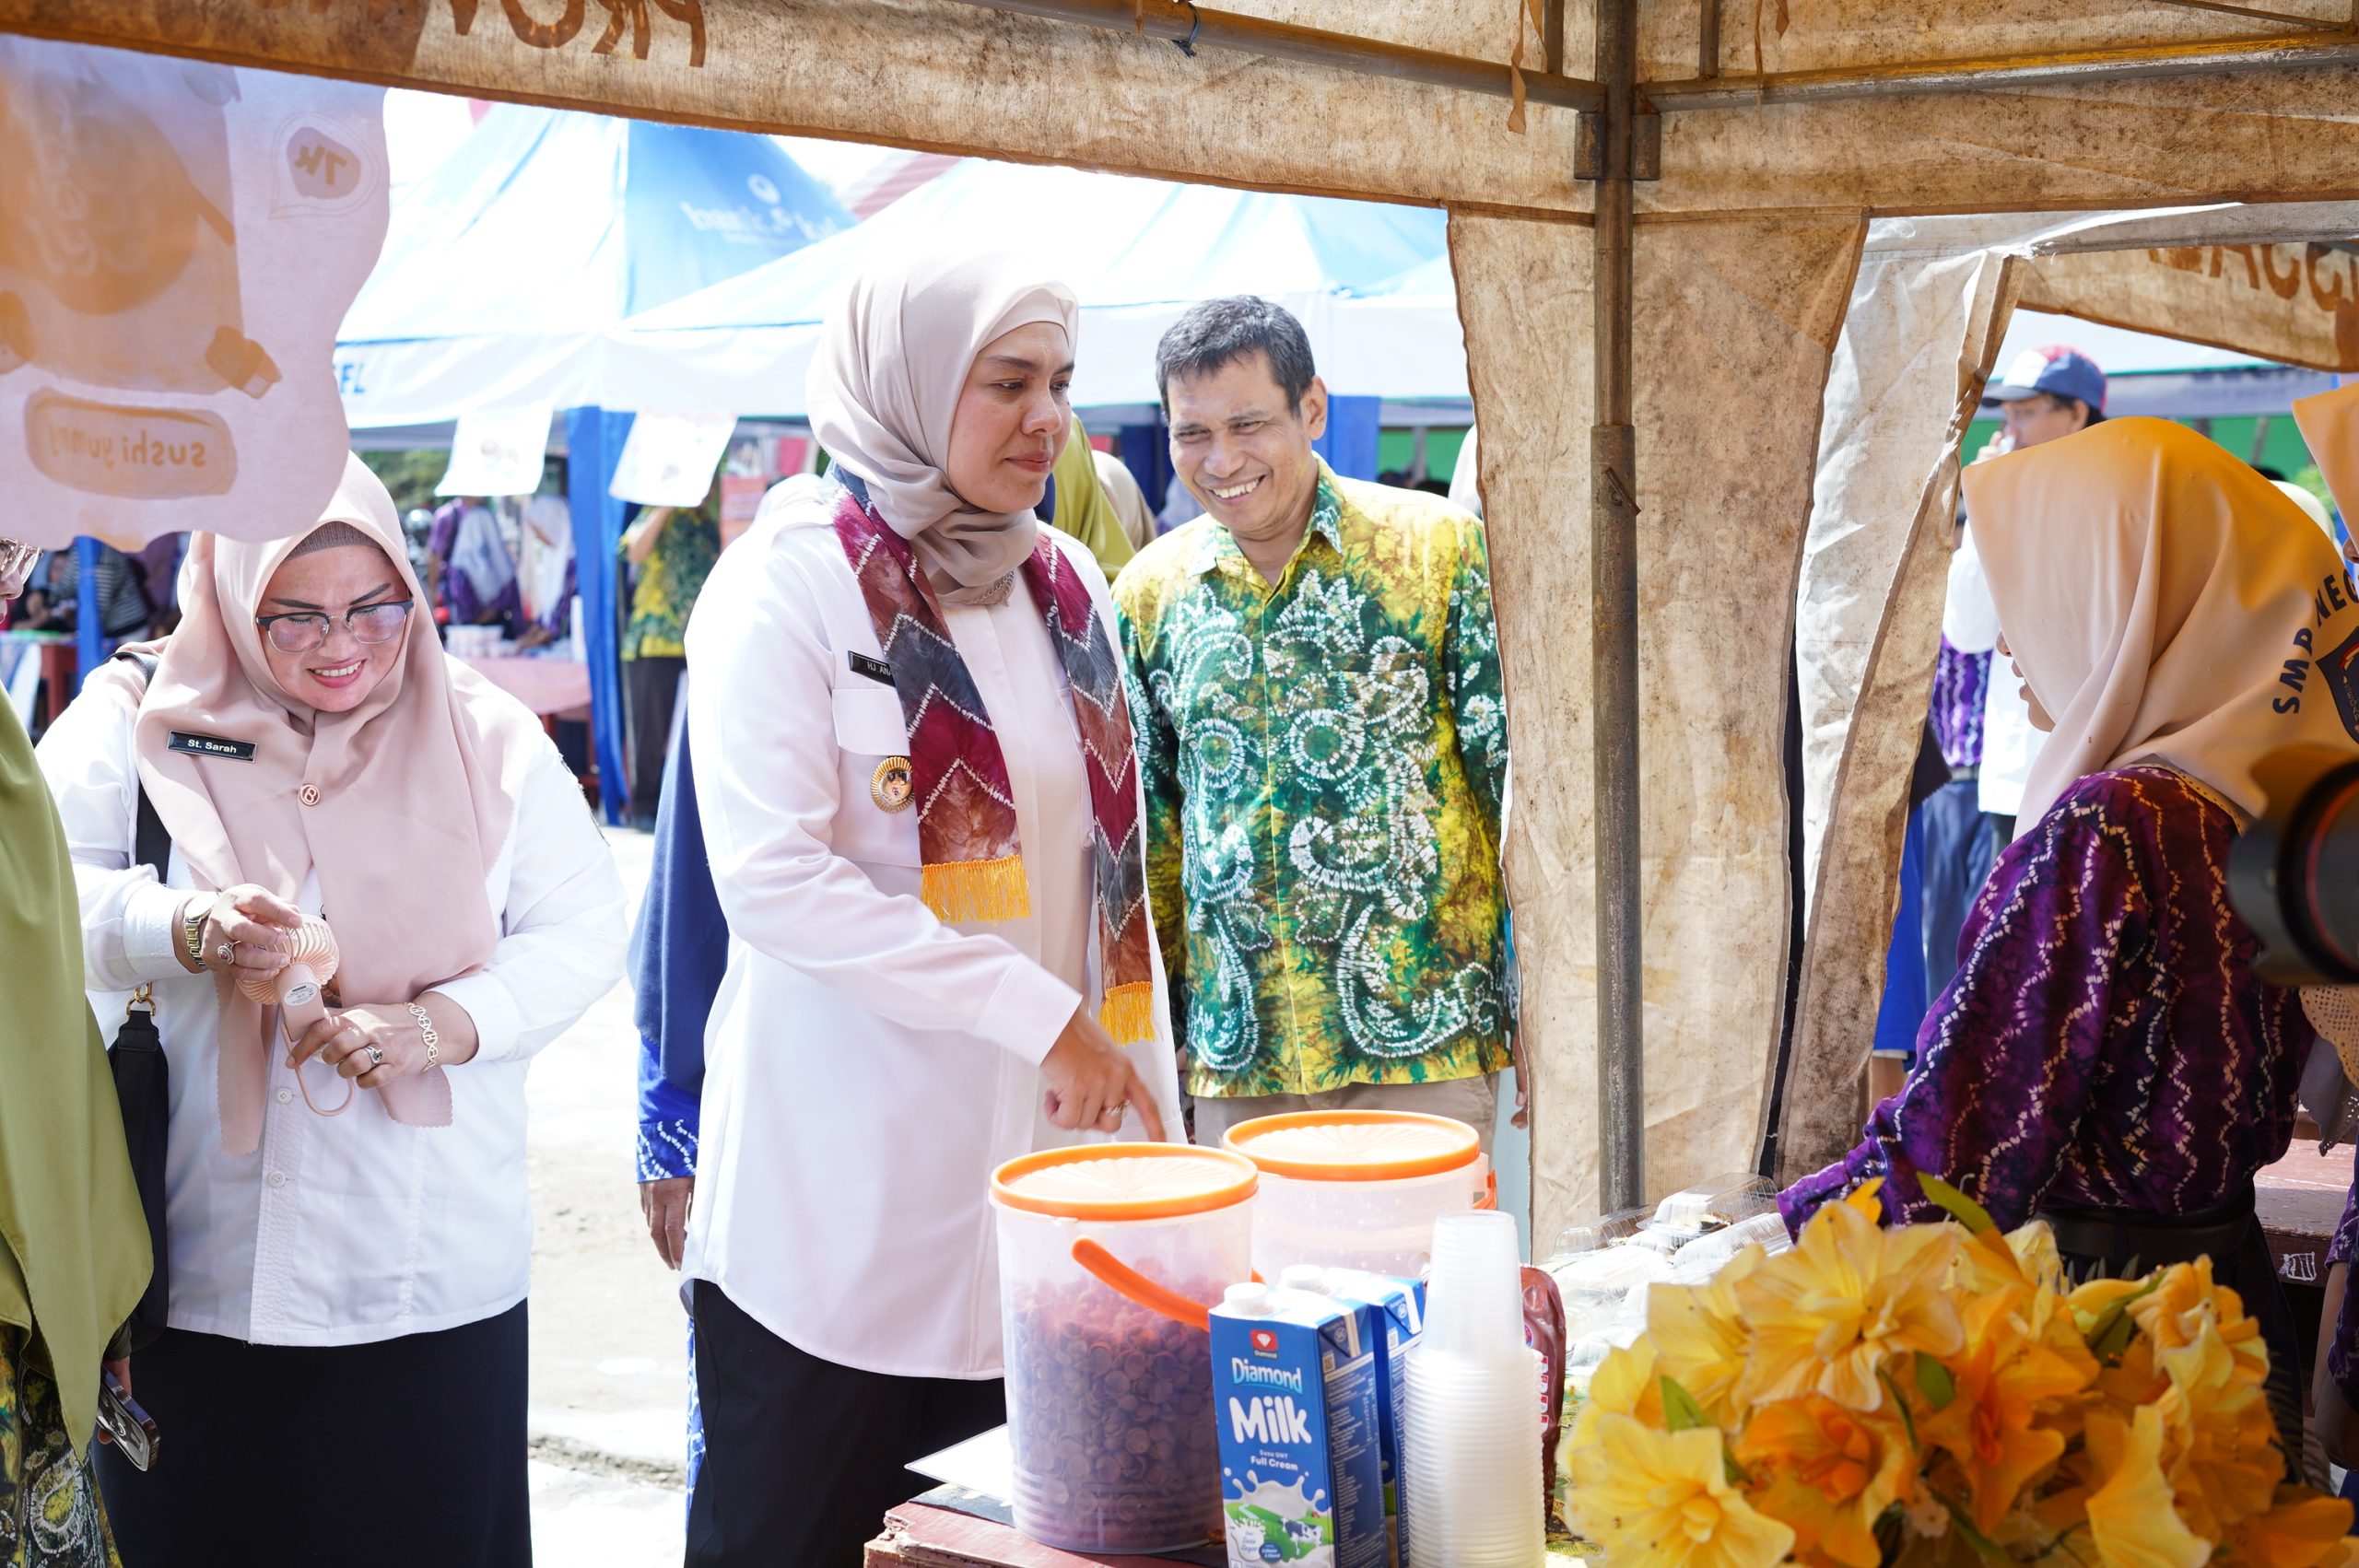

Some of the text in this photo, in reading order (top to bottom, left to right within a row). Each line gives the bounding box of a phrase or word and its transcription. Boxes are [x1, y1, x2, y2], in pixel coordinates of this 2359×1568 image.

[2271, 627, 2313, 715] SMP
[187, 739, 237, 754] St. Sarah
[1231, 1357, 1303, 1395] Diamond
[1228, 1396, 1312, 1444] Milk
[1250, 1455, 1298, 1471] Full Cream
